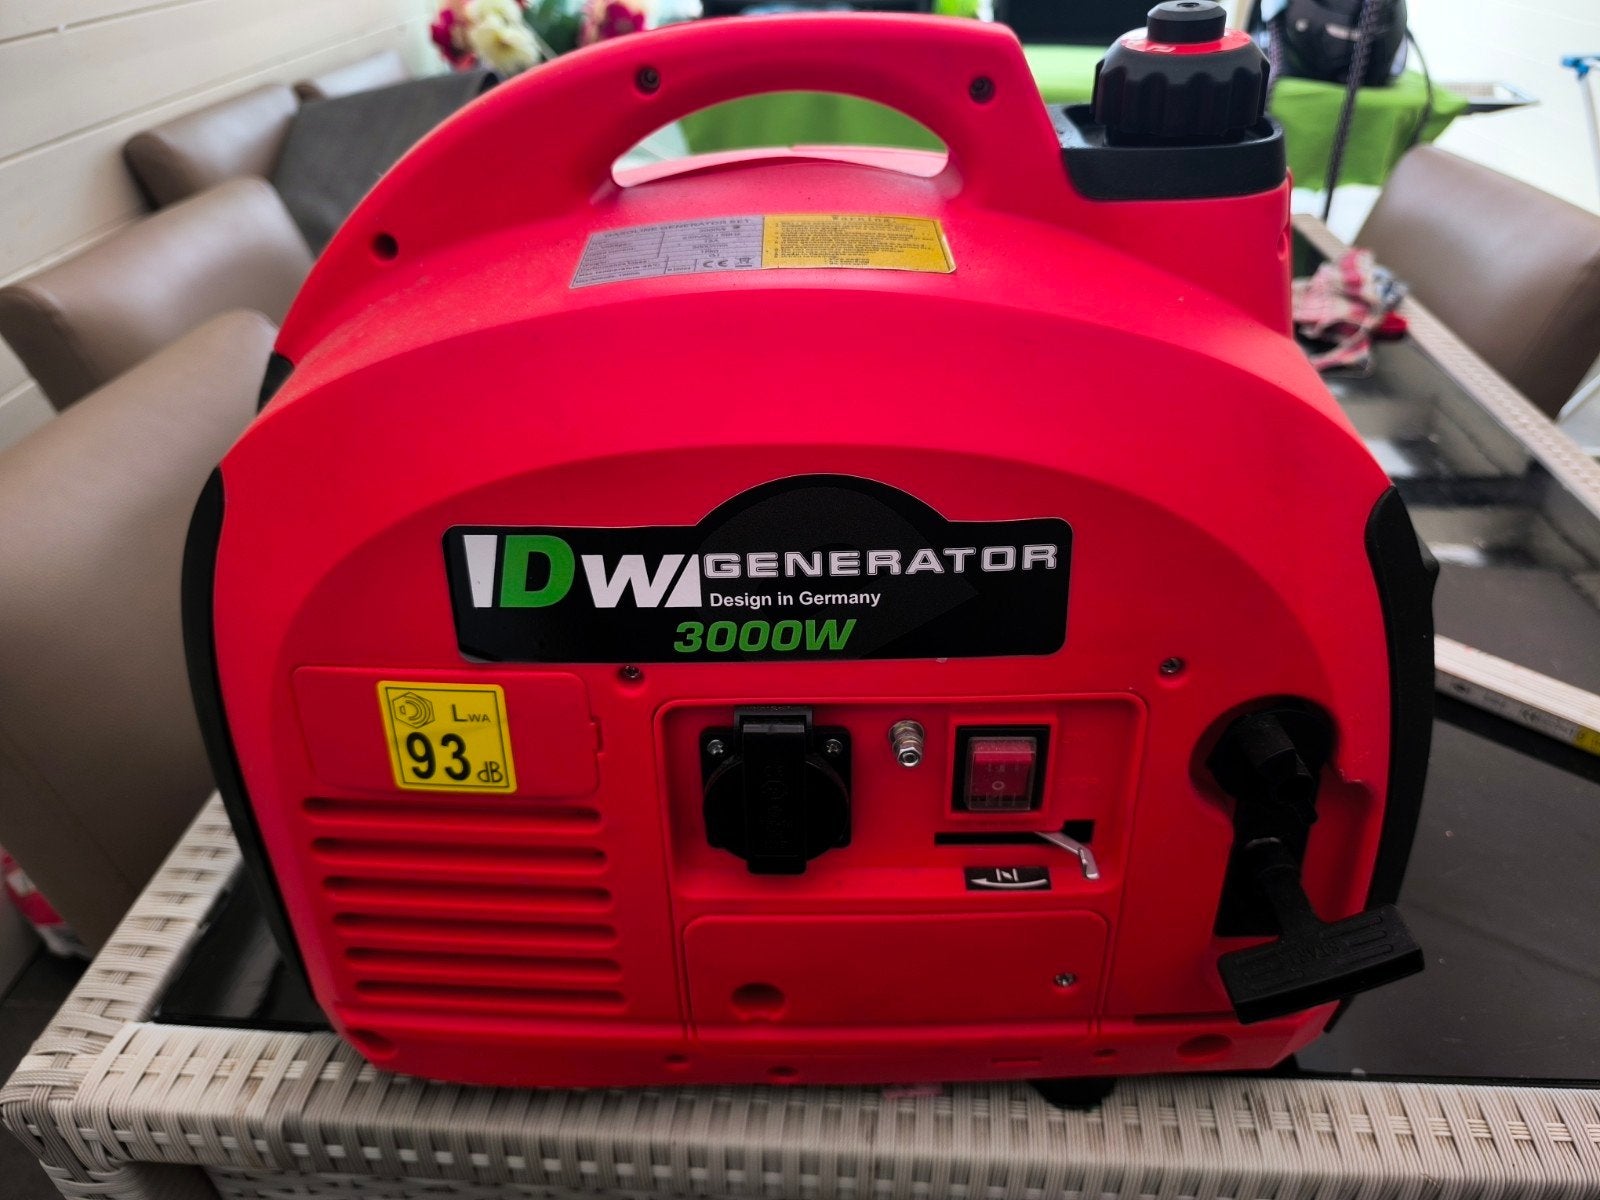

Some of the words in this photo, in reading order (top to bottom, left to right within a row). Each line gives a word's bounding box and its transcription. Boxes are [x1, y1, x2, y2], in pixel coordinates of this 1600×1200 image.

[660, 219, 728, 230] GENERATOR
[703, 543, 1058, 579] GENERATOR
[709, 592, 772, 610] Design
[777, 591, 794, 606] in
[799, 590, 881, 609] Germany
[673, 618, 857, 652] 3000W
[406, 731, 471, 781] 93
[477, 761, 503, 783] dB
